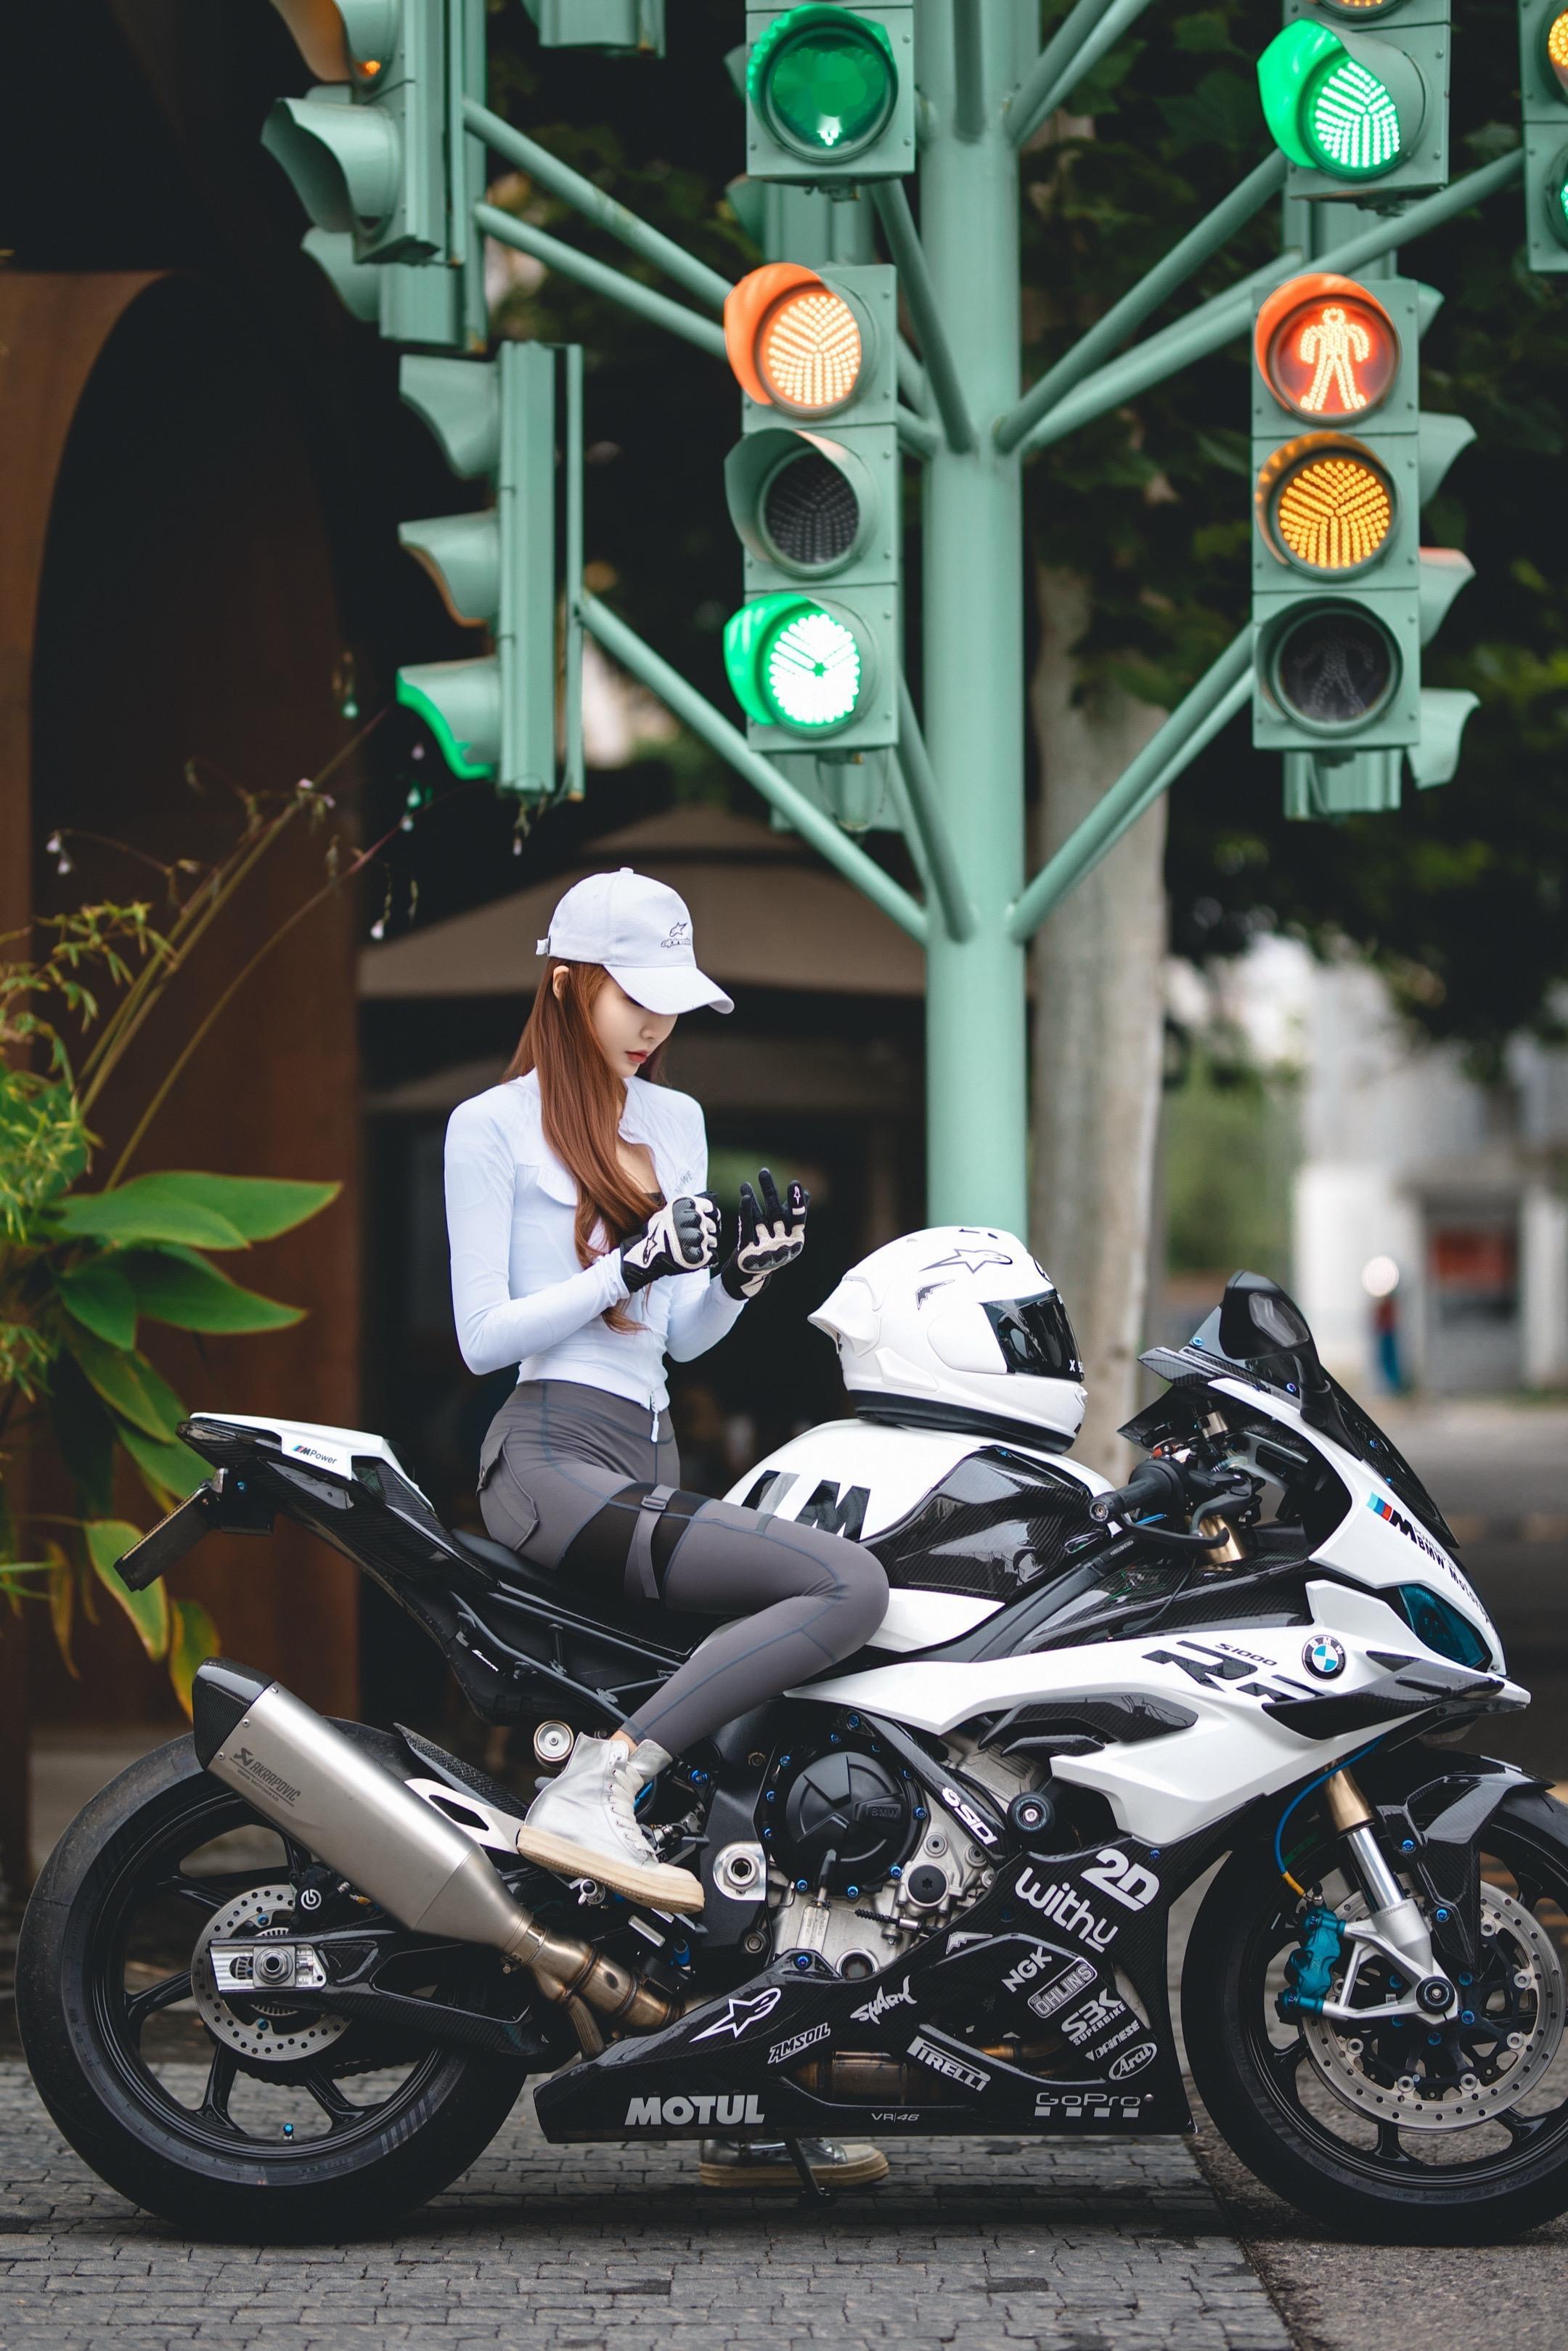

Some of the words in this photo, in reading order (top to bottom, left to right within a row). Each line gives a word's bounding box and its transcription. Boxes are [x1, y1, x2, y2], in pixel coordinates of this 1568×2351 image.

[1416, 1535, 1445, 1569] BMW
[1215, 1643, 1278, 1666] S1000
[1001, 1946, 1053, 1993] NGK
[767, 2022, 830, 2064] AMSOIL
[1071, 2002, 1127, 2047] SUPERBIKE
[907, 2035, 992, 2091] PIRELLI
[624, 2094, 765, 2126] MOTUL
